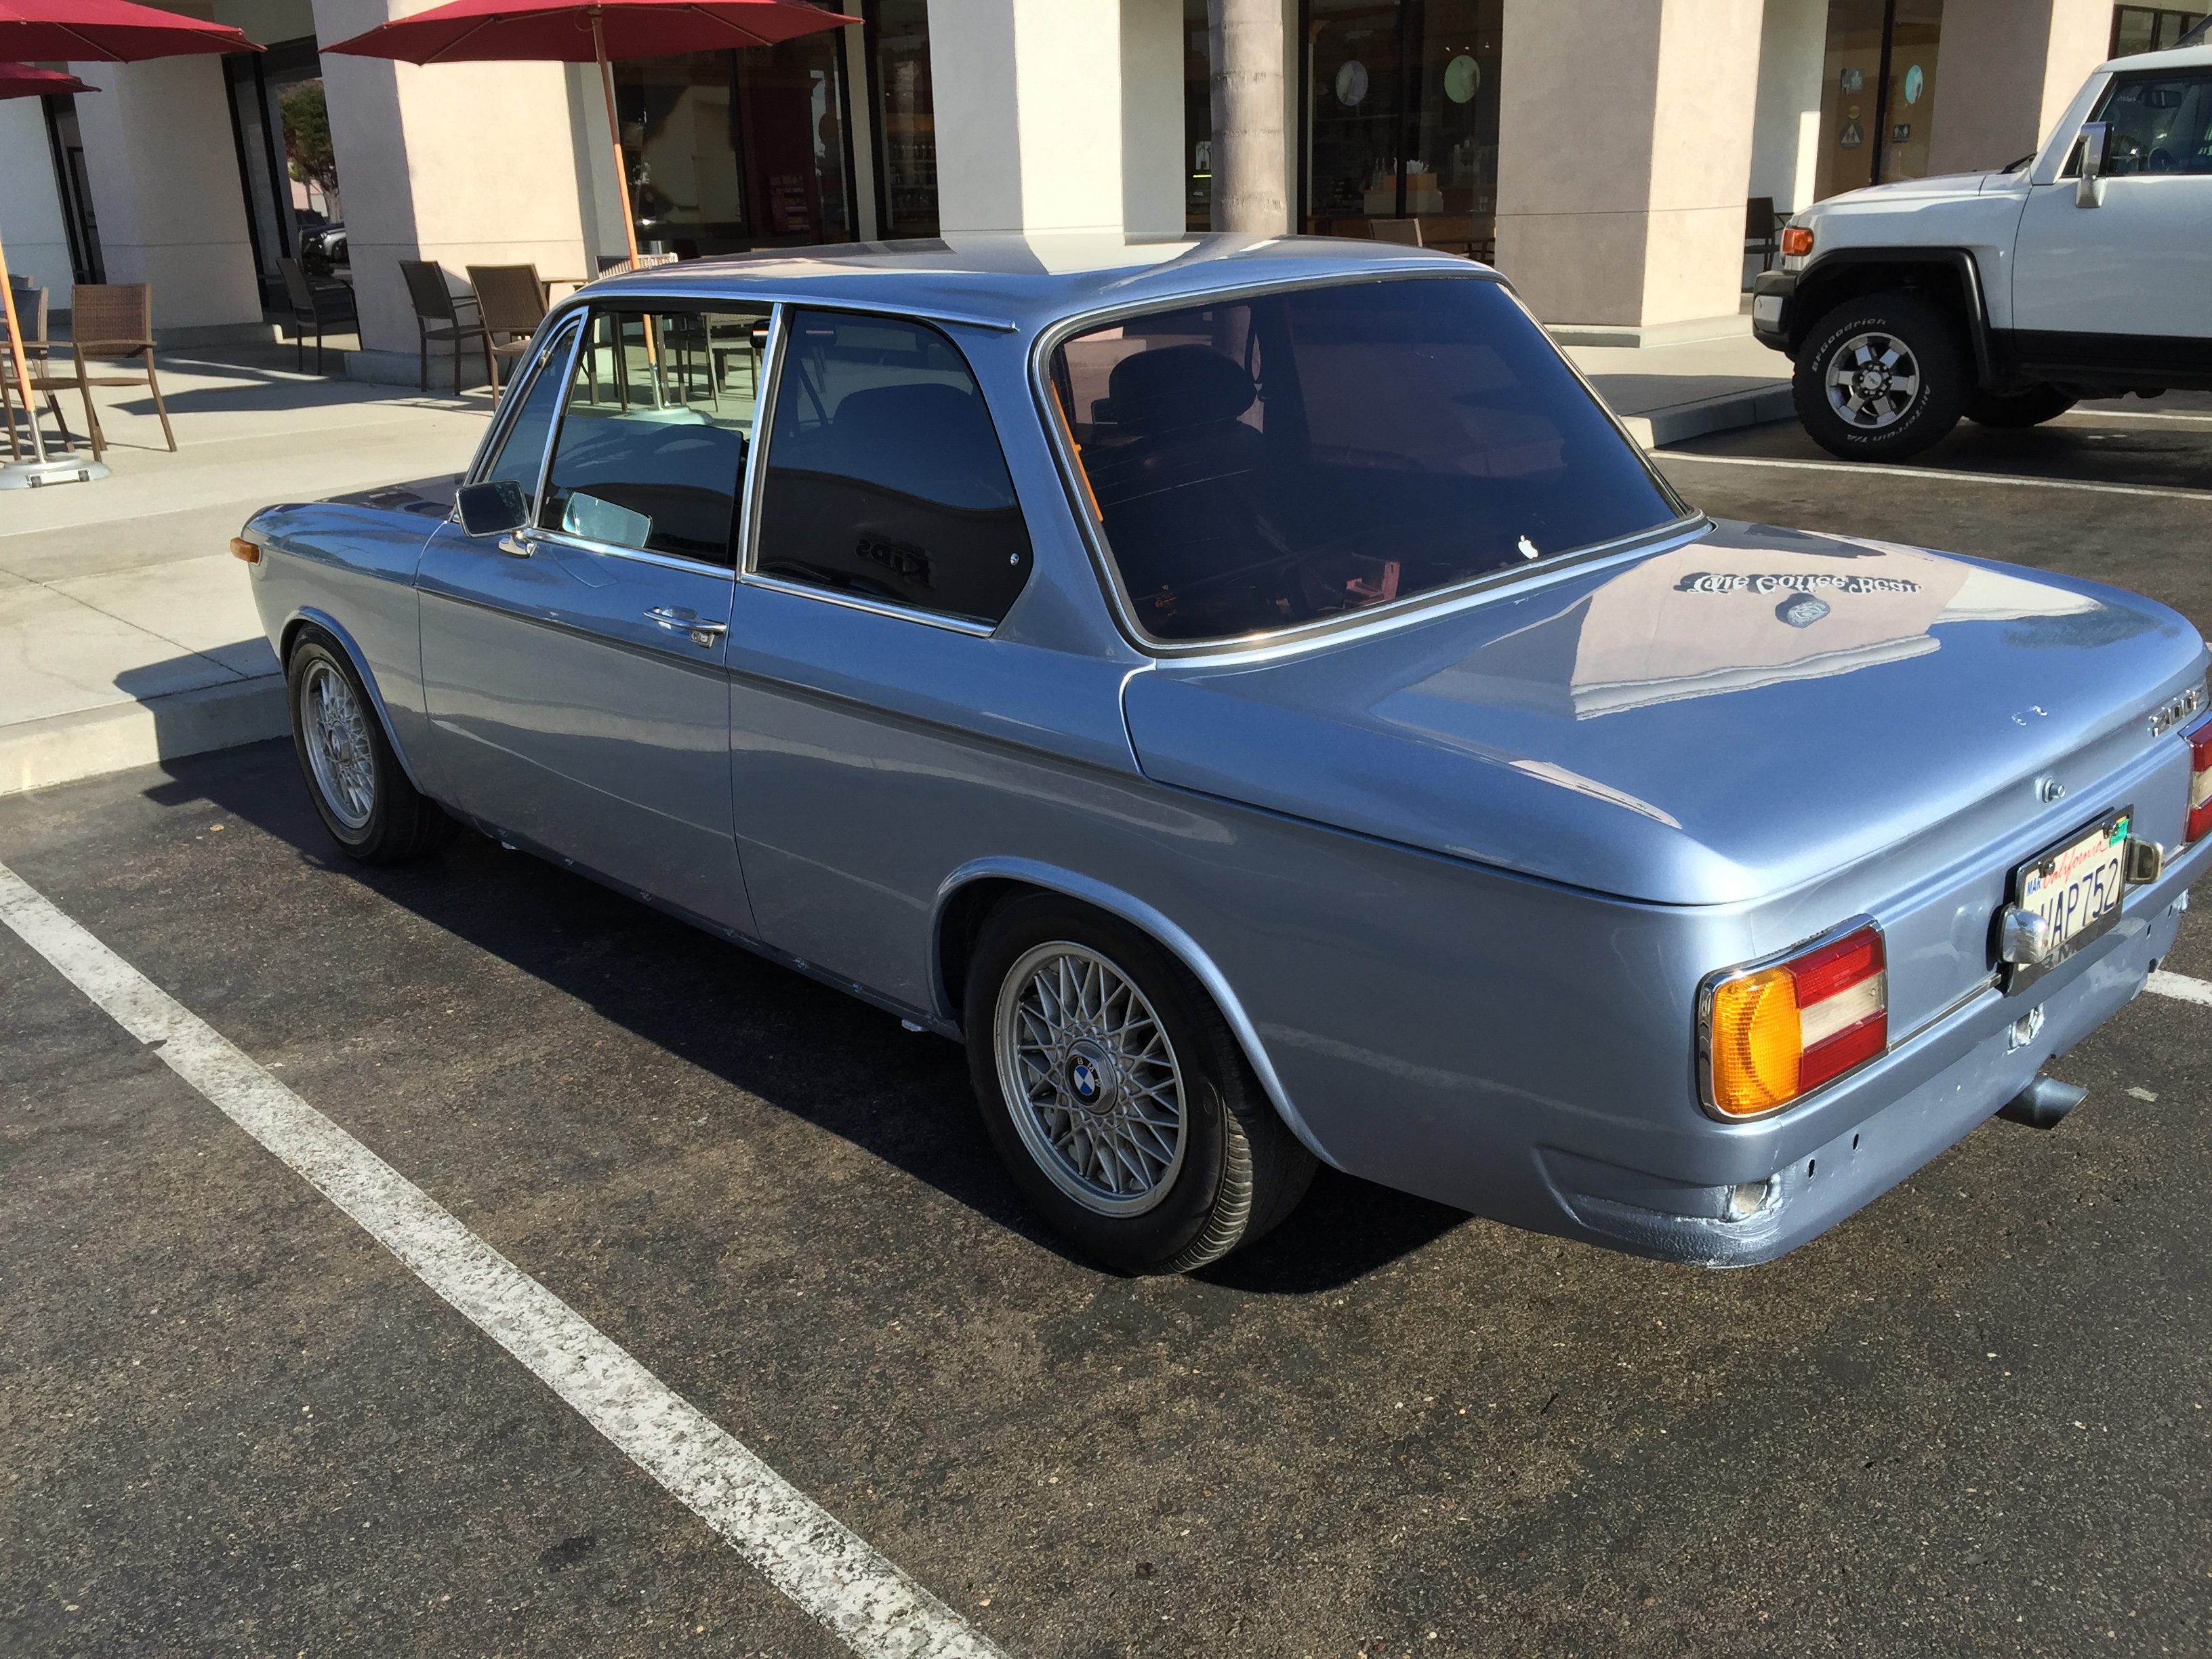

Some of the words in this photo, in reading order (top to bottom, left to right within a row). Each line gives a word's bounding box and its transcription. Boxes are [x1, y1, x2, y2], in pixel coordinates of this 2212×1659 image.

[2043, 840, 2107, 889] California
[2032, 859, 2118, 946] AP752
[1077, 1057, 1101, 1087] BMW
